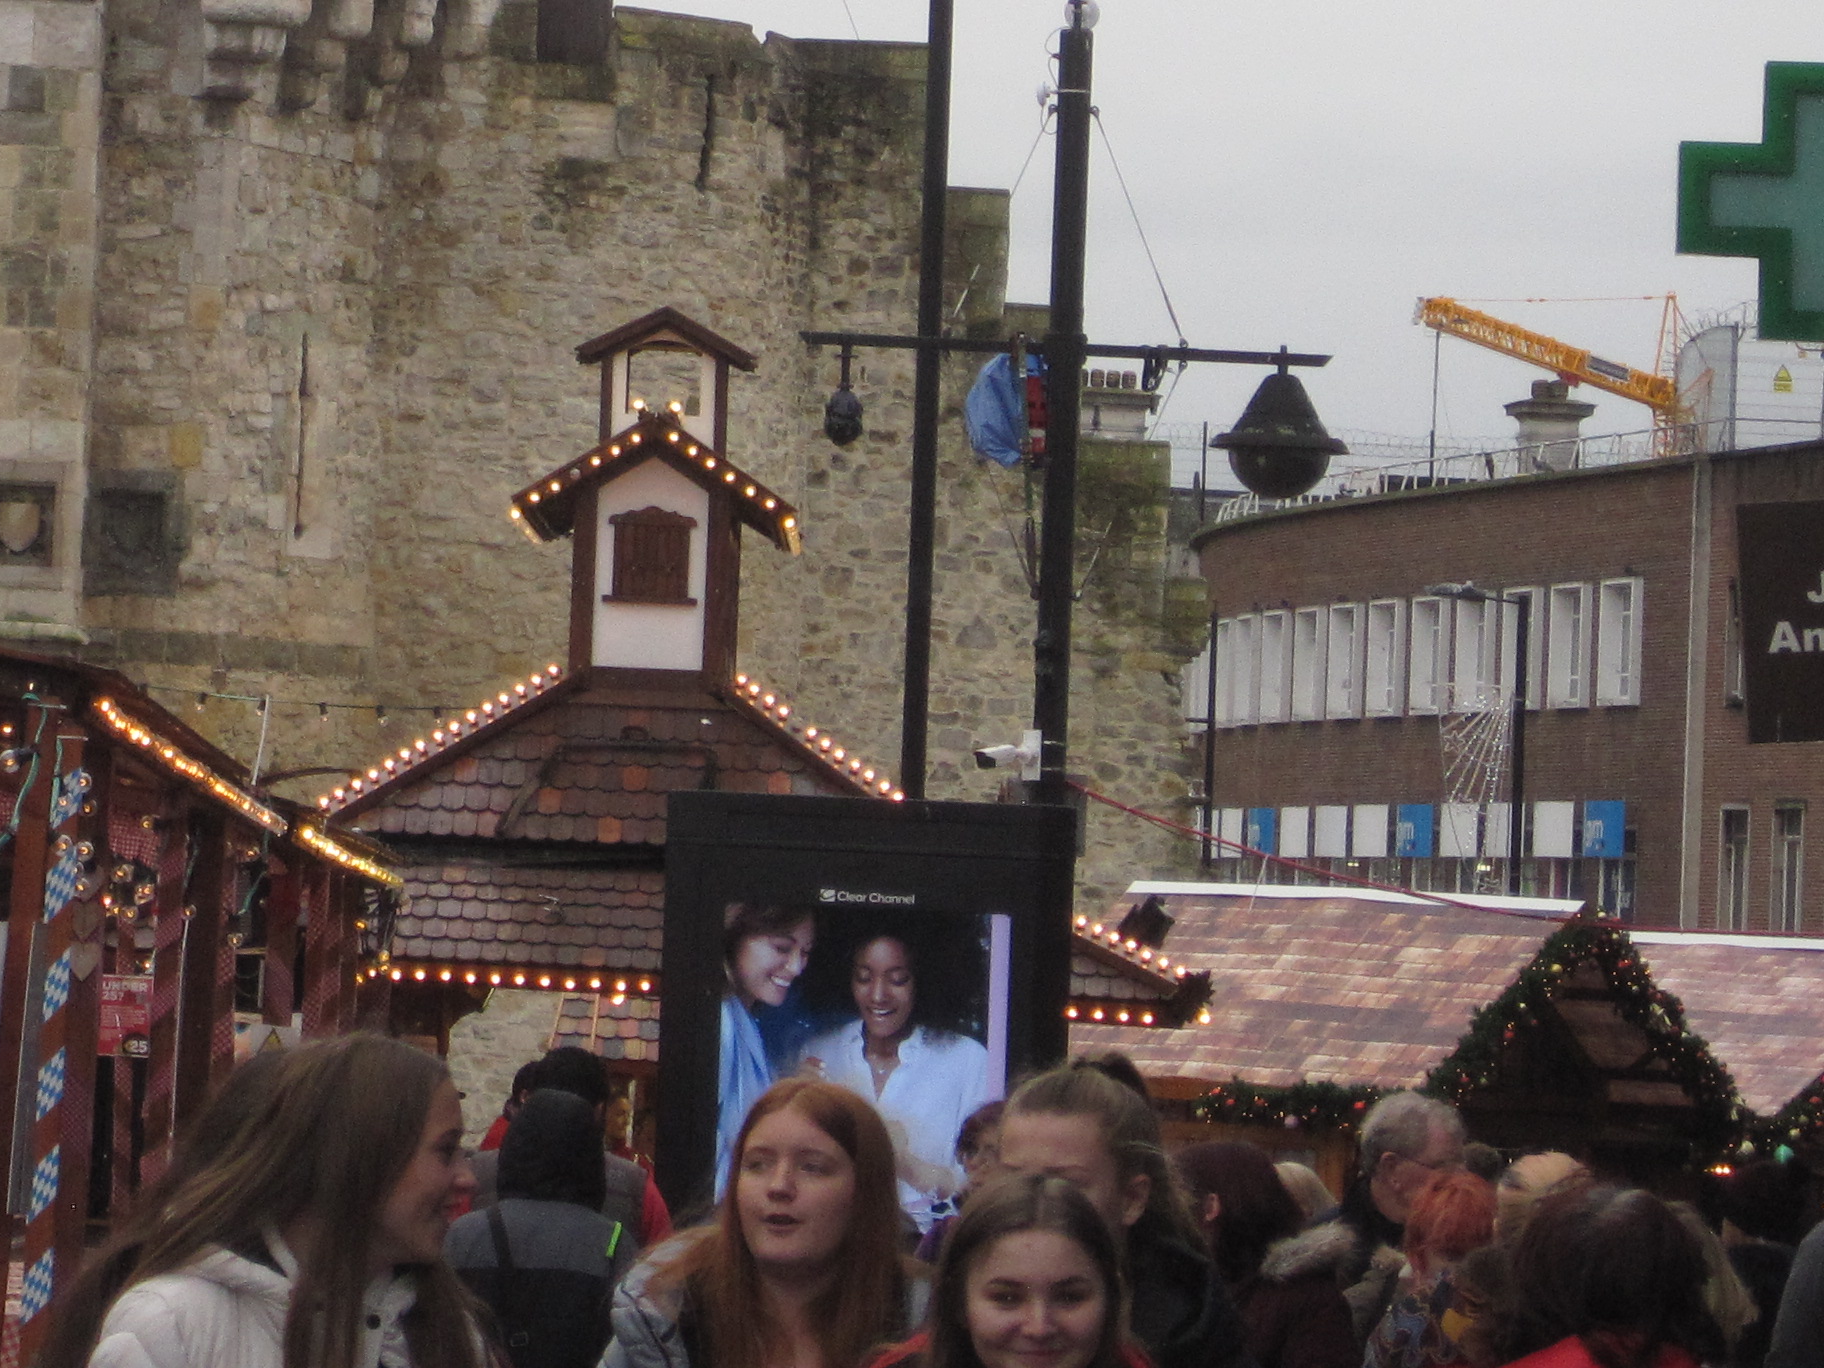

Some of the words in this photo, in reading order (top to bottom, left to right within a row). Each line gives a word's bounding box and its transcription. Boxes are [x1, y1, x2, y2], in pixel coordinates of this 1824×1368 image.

[837, 891, 867, 902] Clear
[869, 892, 915, 904] Channel
[102, 981, 148, 992] UNDER
[131, 1040, 148, 1053] 25
